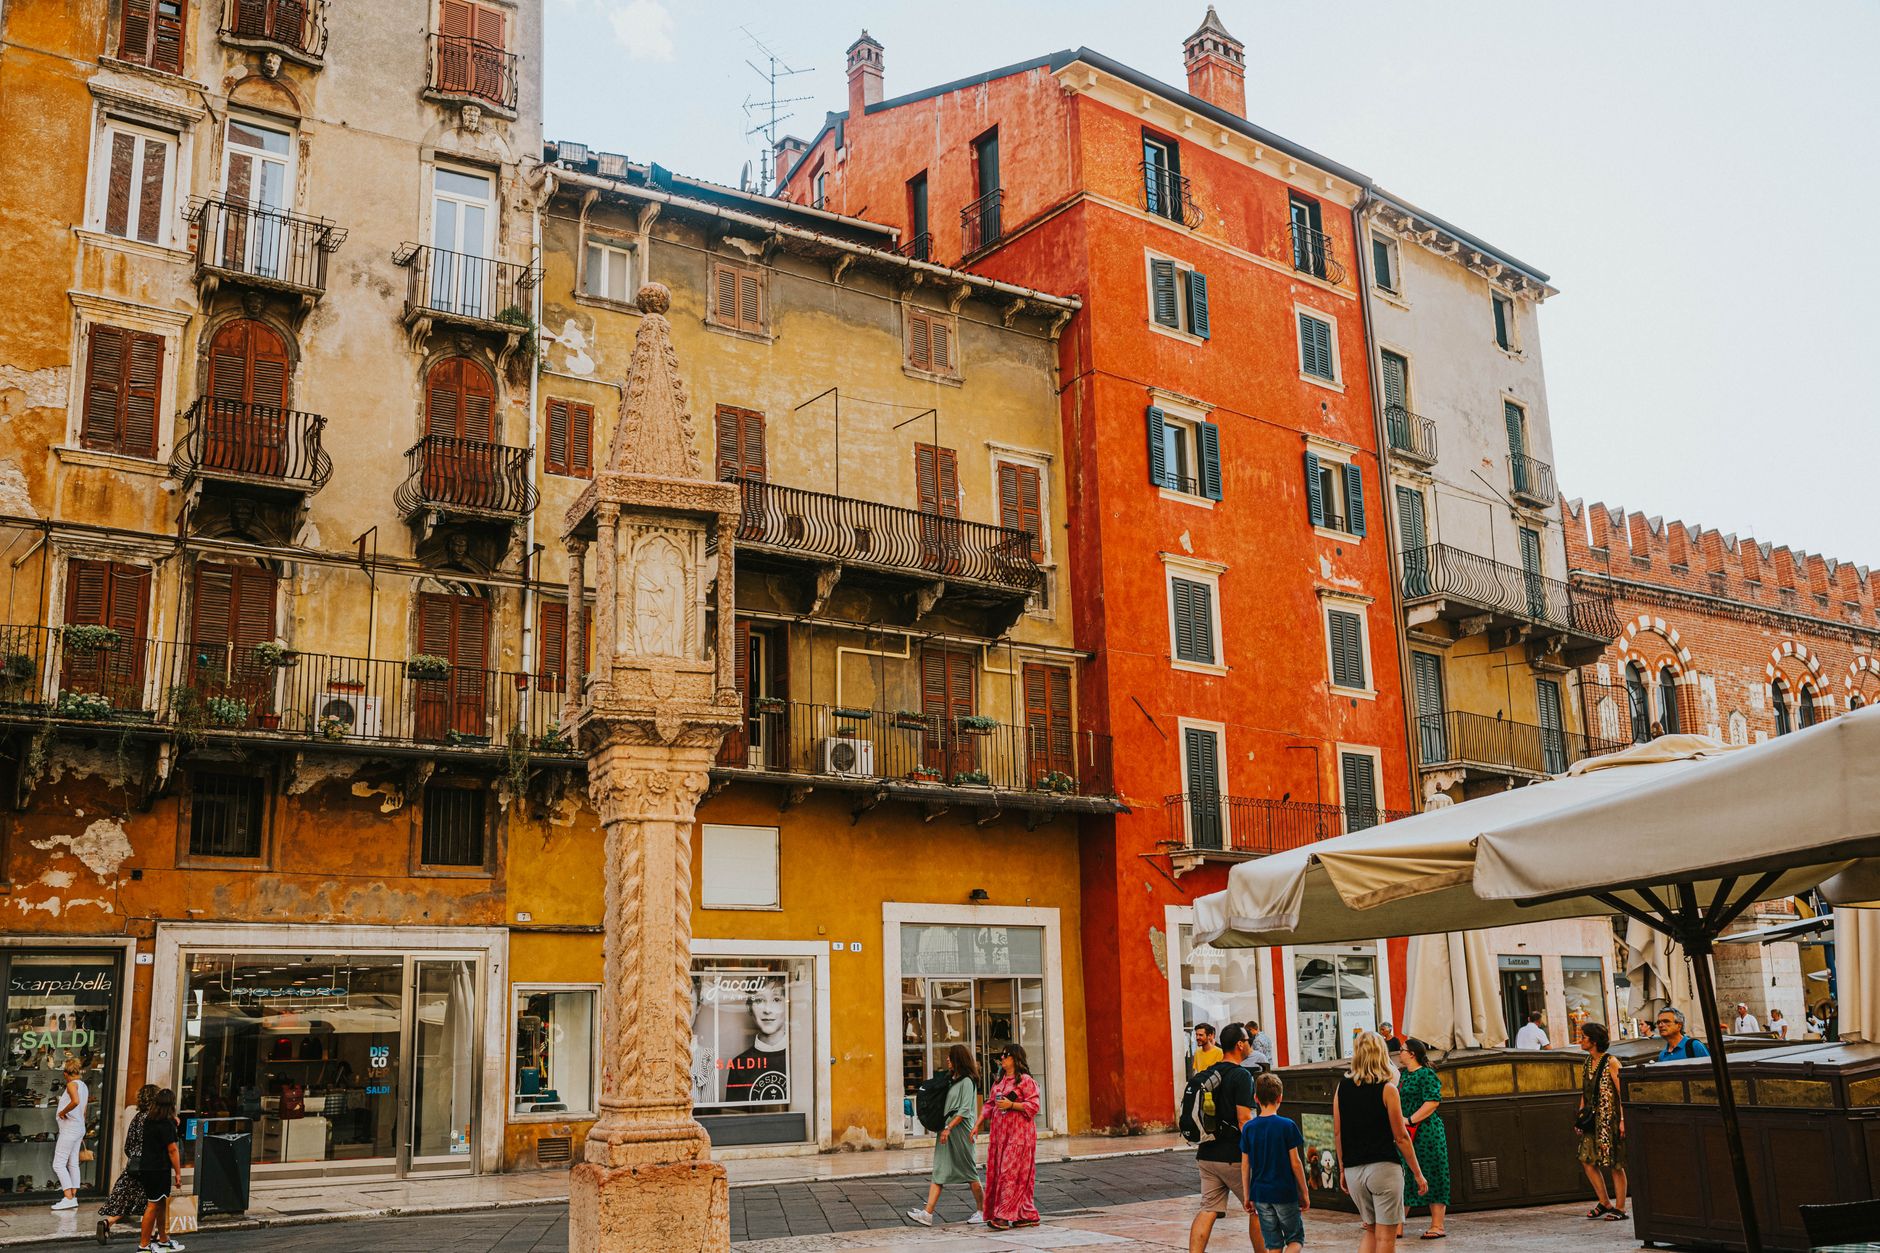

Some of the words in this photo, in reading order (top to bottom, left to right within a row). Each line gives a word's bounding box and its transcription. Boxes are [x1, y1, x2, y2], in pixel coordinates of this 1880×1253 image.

[493, 964, 499, 974] 7
[9, 972, 112, 999] Scarpabella
[705, 975, 766, 1001] Jacadi
[21, 1030, 95, 1050] SALDI
[370, 1046, 390, 1057] DIS
[371, 1057, 388, 1068] CO
[715, 1057, 768, 1070] SALDI!
[366, 1085, 391, 1095] SALDI
[752, 1074, 788, 1094] l'espri
[170, 1215, 198, 1232] ZARA
